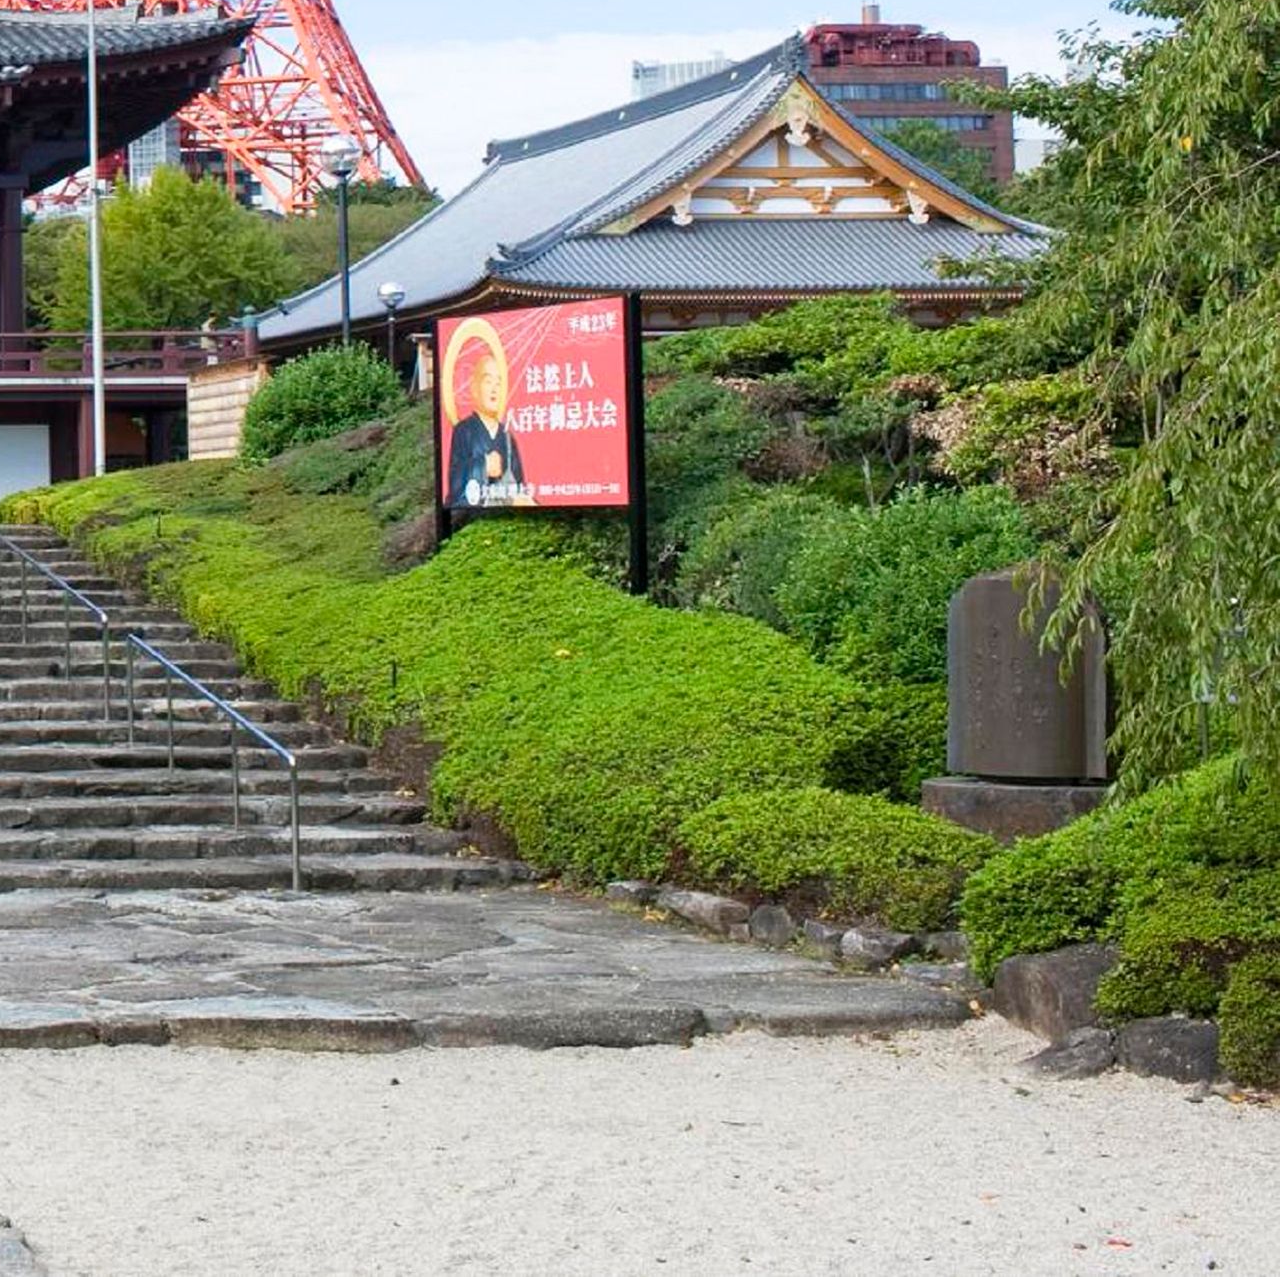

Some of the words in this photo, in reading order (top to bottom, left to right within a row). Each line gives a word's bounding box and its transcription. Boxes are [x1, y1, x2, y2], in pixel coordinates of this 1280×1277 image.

[567, 312, 617, 334] 平成23年
[526, 361, 594, 394] 法然上人
[503, 398, 617, 433] 八百年御忌大会
